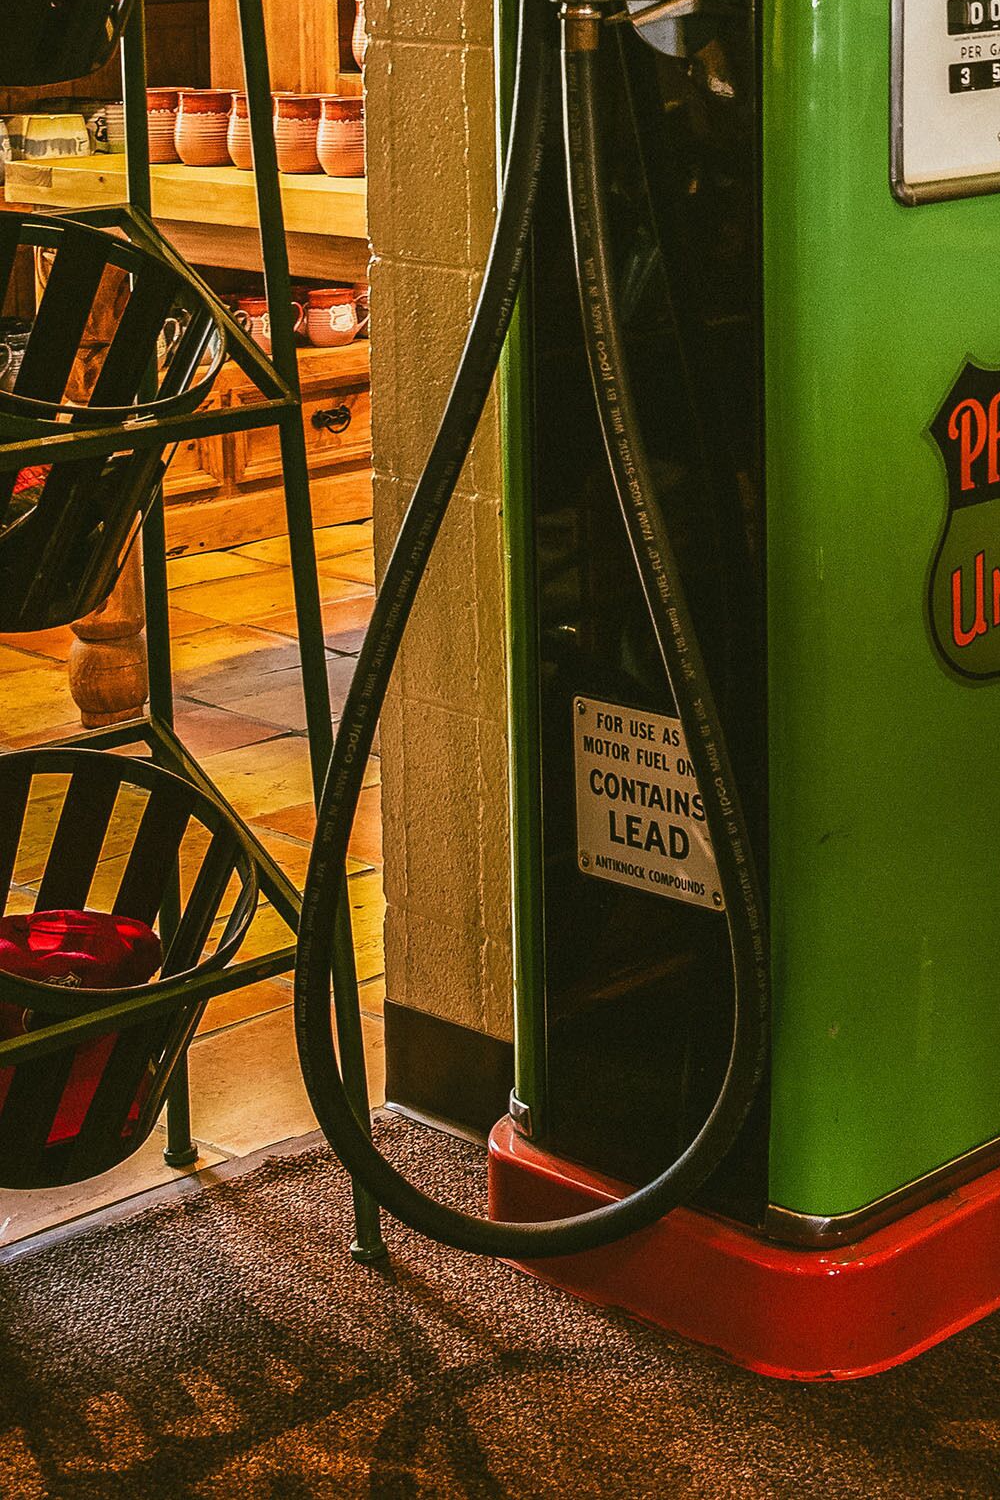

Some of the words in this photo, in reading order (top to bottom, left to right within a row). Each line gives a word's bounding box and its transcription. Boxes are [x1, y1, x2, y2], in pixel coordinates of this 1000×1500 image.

[960, 45, 982, 58] PER
[597, 712, 623, 734] FOR
[630, 720, 655, 742] USE
[662, 727, 680, 747] AS
[583, 735, 630, 762] MOTOR
[636, 749, 670, 772] FUEL
[676, 758, 696, 778] ON
[590, 768, 706, 822] CONTAINS
[609, 810, 691, 860] LEAD
[595, 854, 645, 880] ANTIKNOCK
[649, 869, 705, 896] COMPOUNDS
